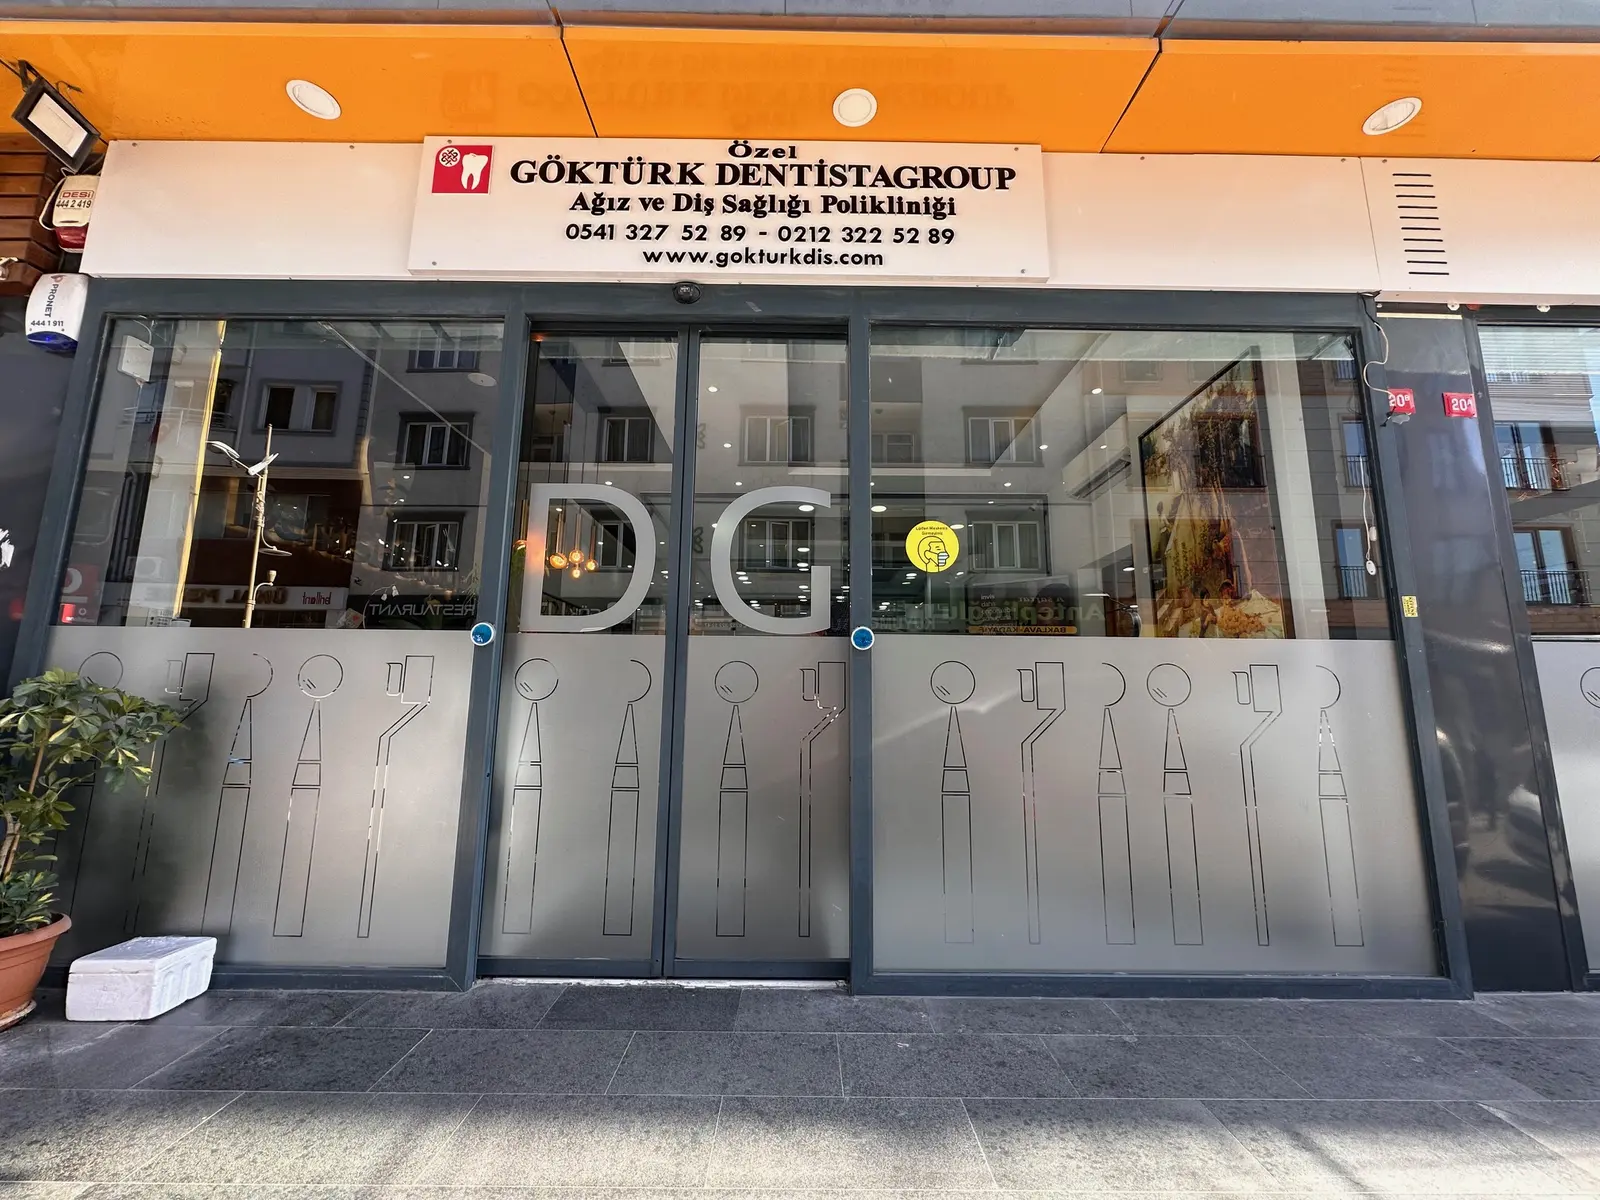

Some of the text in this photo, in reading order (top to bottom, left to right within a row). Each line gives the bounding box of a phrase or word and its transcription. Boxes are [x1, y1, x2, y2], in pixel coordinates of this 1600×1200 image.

[728, 139, 798, 159] Özel
[510, 154, 1017, 190] GÖKTÜRK DENTİSTAGROUP
[56, 199, 92, 209] 444 2 419
[569, 191, 957, 221] Ağız ve Diş Sağlığı Polikliniği
[565, 223, 615, 241] 0541
[625, 223, 669, 241] 327
[681, 224, 708, 241] 52
[720, 224, 746, 242] 89
[777, 225, 831, 243] 0212
[841, 226, 882, 244] 322
[892, 227, 920, 244] 52
[928, 227, 955, 245] 89
[643, 246, 883, 268] www.gokturkdis.com
[44, 283, 59, 318] PRONET
